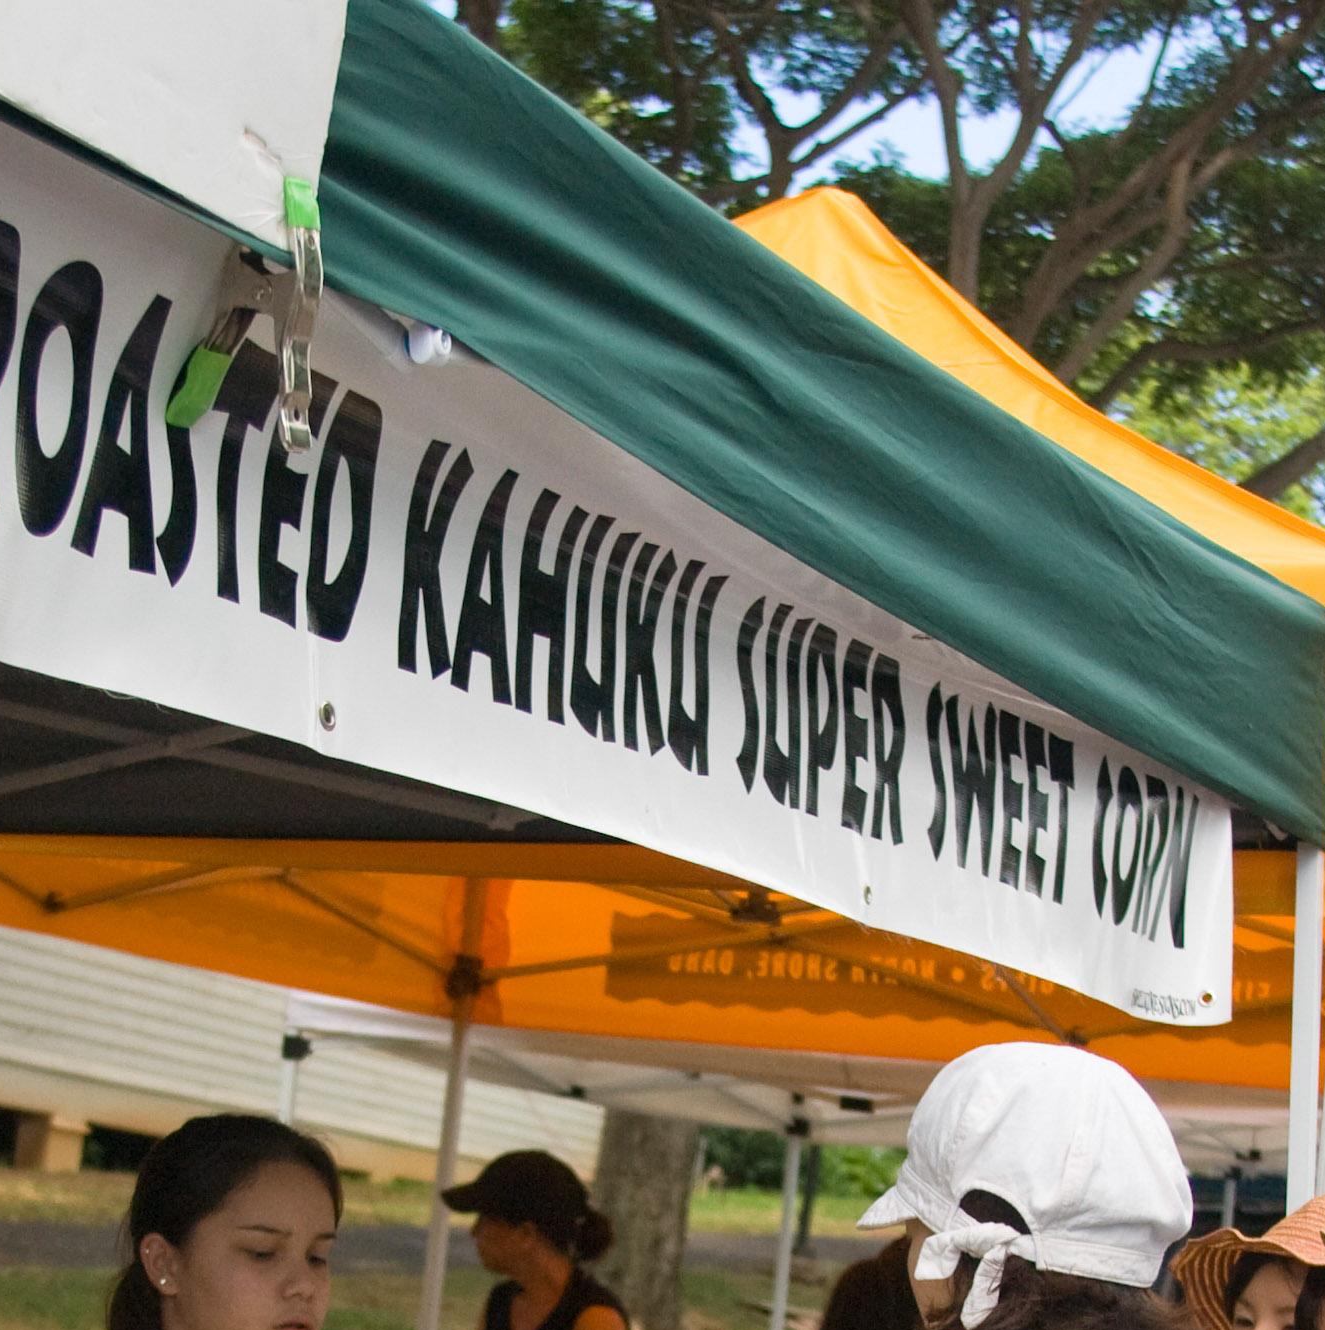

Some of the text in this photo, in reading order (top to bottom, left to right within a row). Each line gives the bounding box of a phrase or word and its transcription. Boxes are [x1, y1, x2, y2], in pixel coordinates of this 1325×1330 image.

[397, 439, 729, 777] KAHUKU
[735, 595, 905, 847] SUPER
[926, 680, 1075, 905] SWEET
[1092, 755, 1200, 949] CORN
